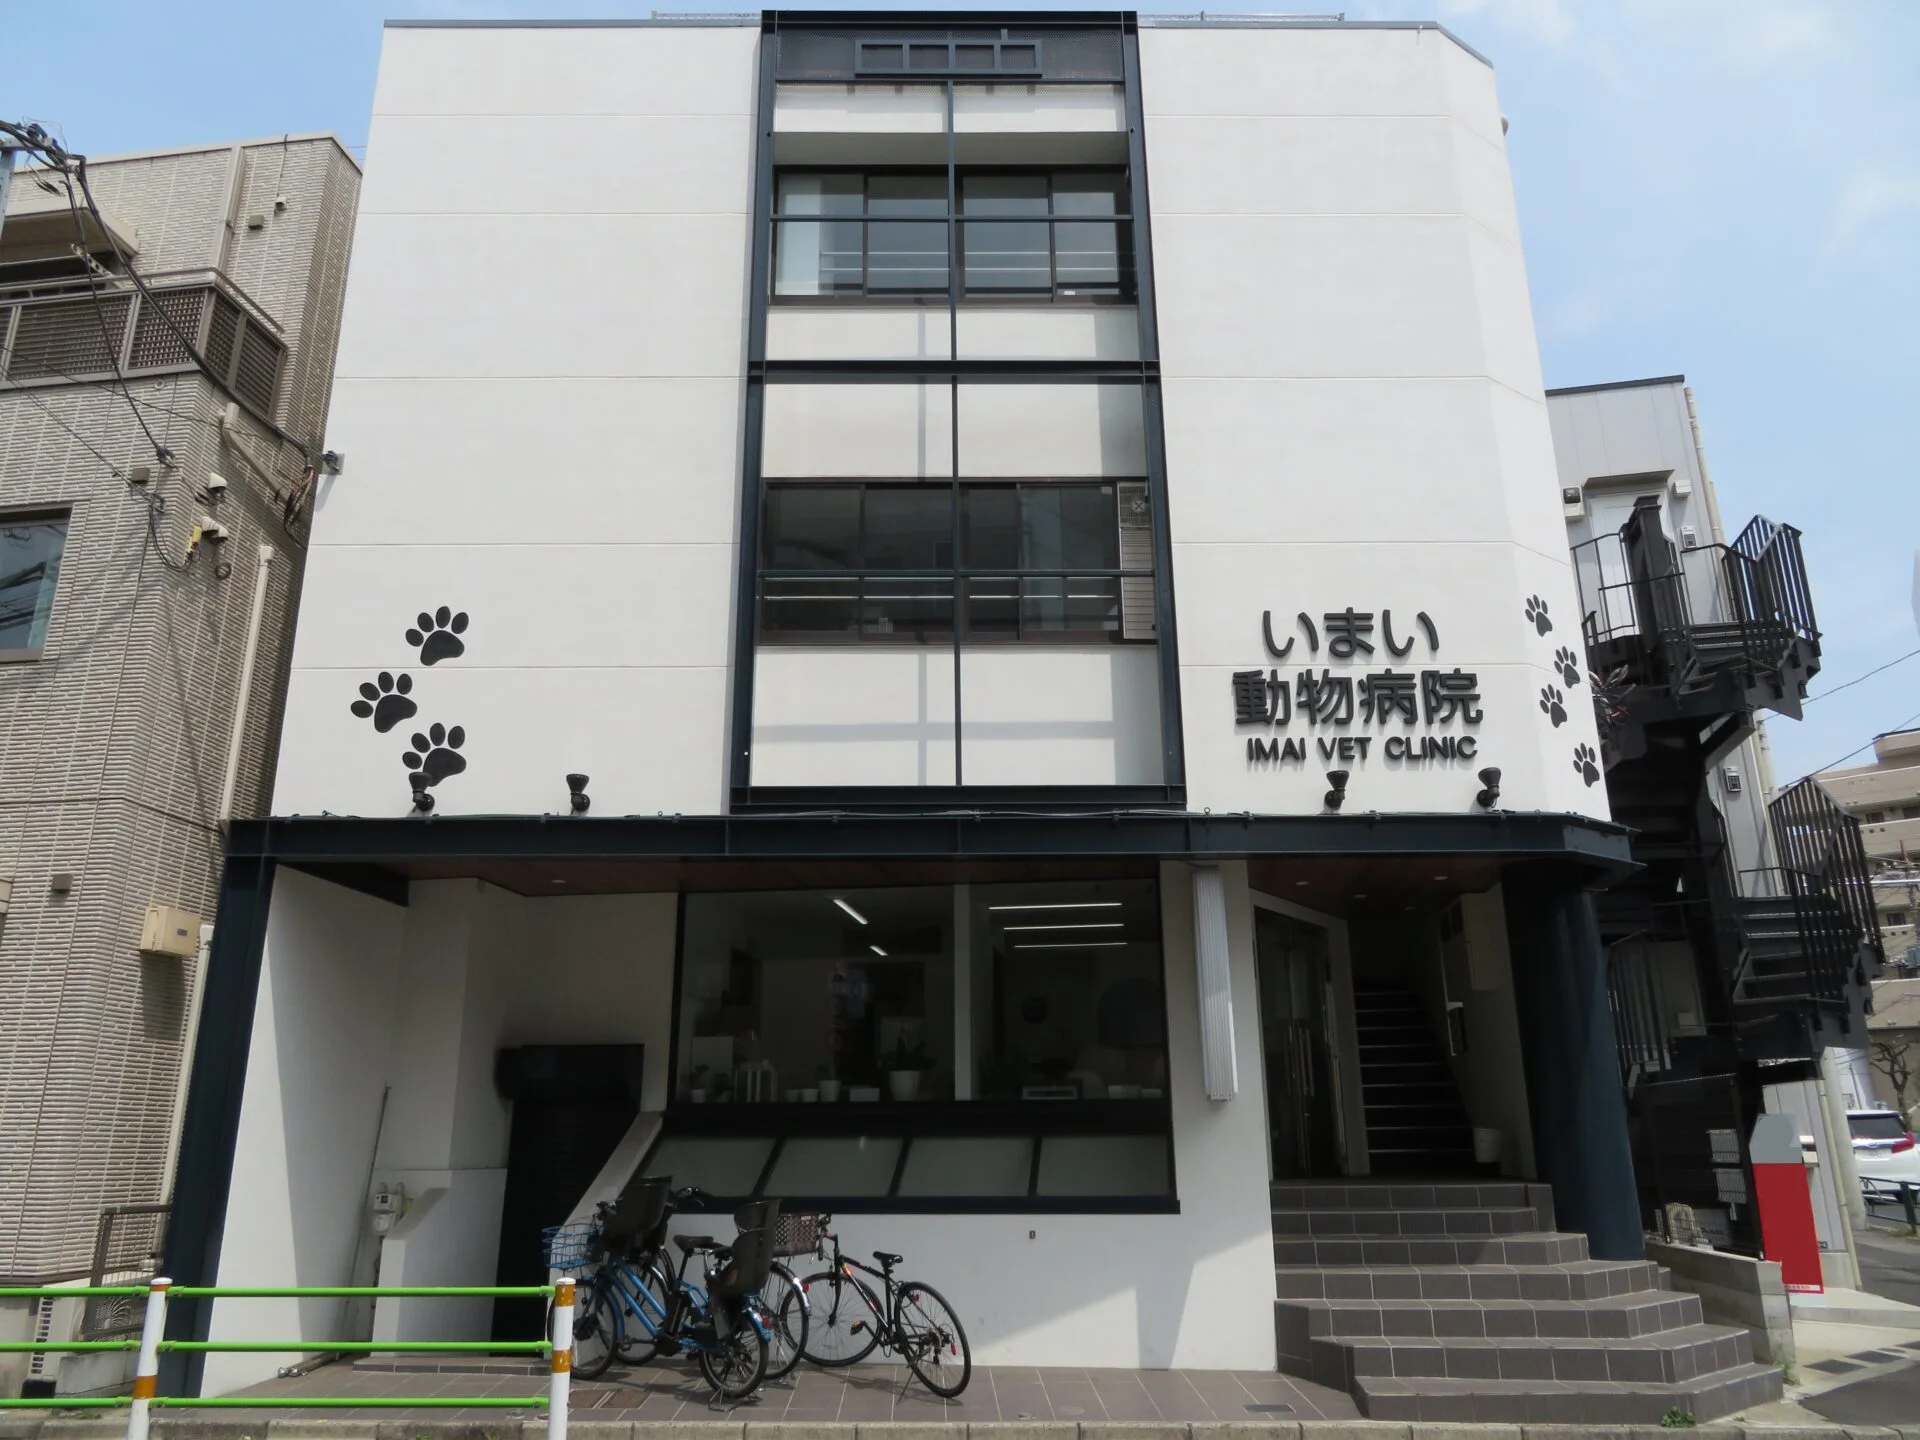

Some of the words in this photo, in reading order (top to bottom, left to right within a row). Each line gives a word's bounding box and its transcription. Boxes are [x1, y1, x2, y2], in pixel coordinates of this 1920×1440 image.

[1262, 607, 1440, 658] いまい
[1233, 668, 1484, 725] 動物病院
[1247, 737, 1307, 761] IMAI
[1317, 737, 1372, 761] VET
[1385, 736, 1478, 760] CLINIC
